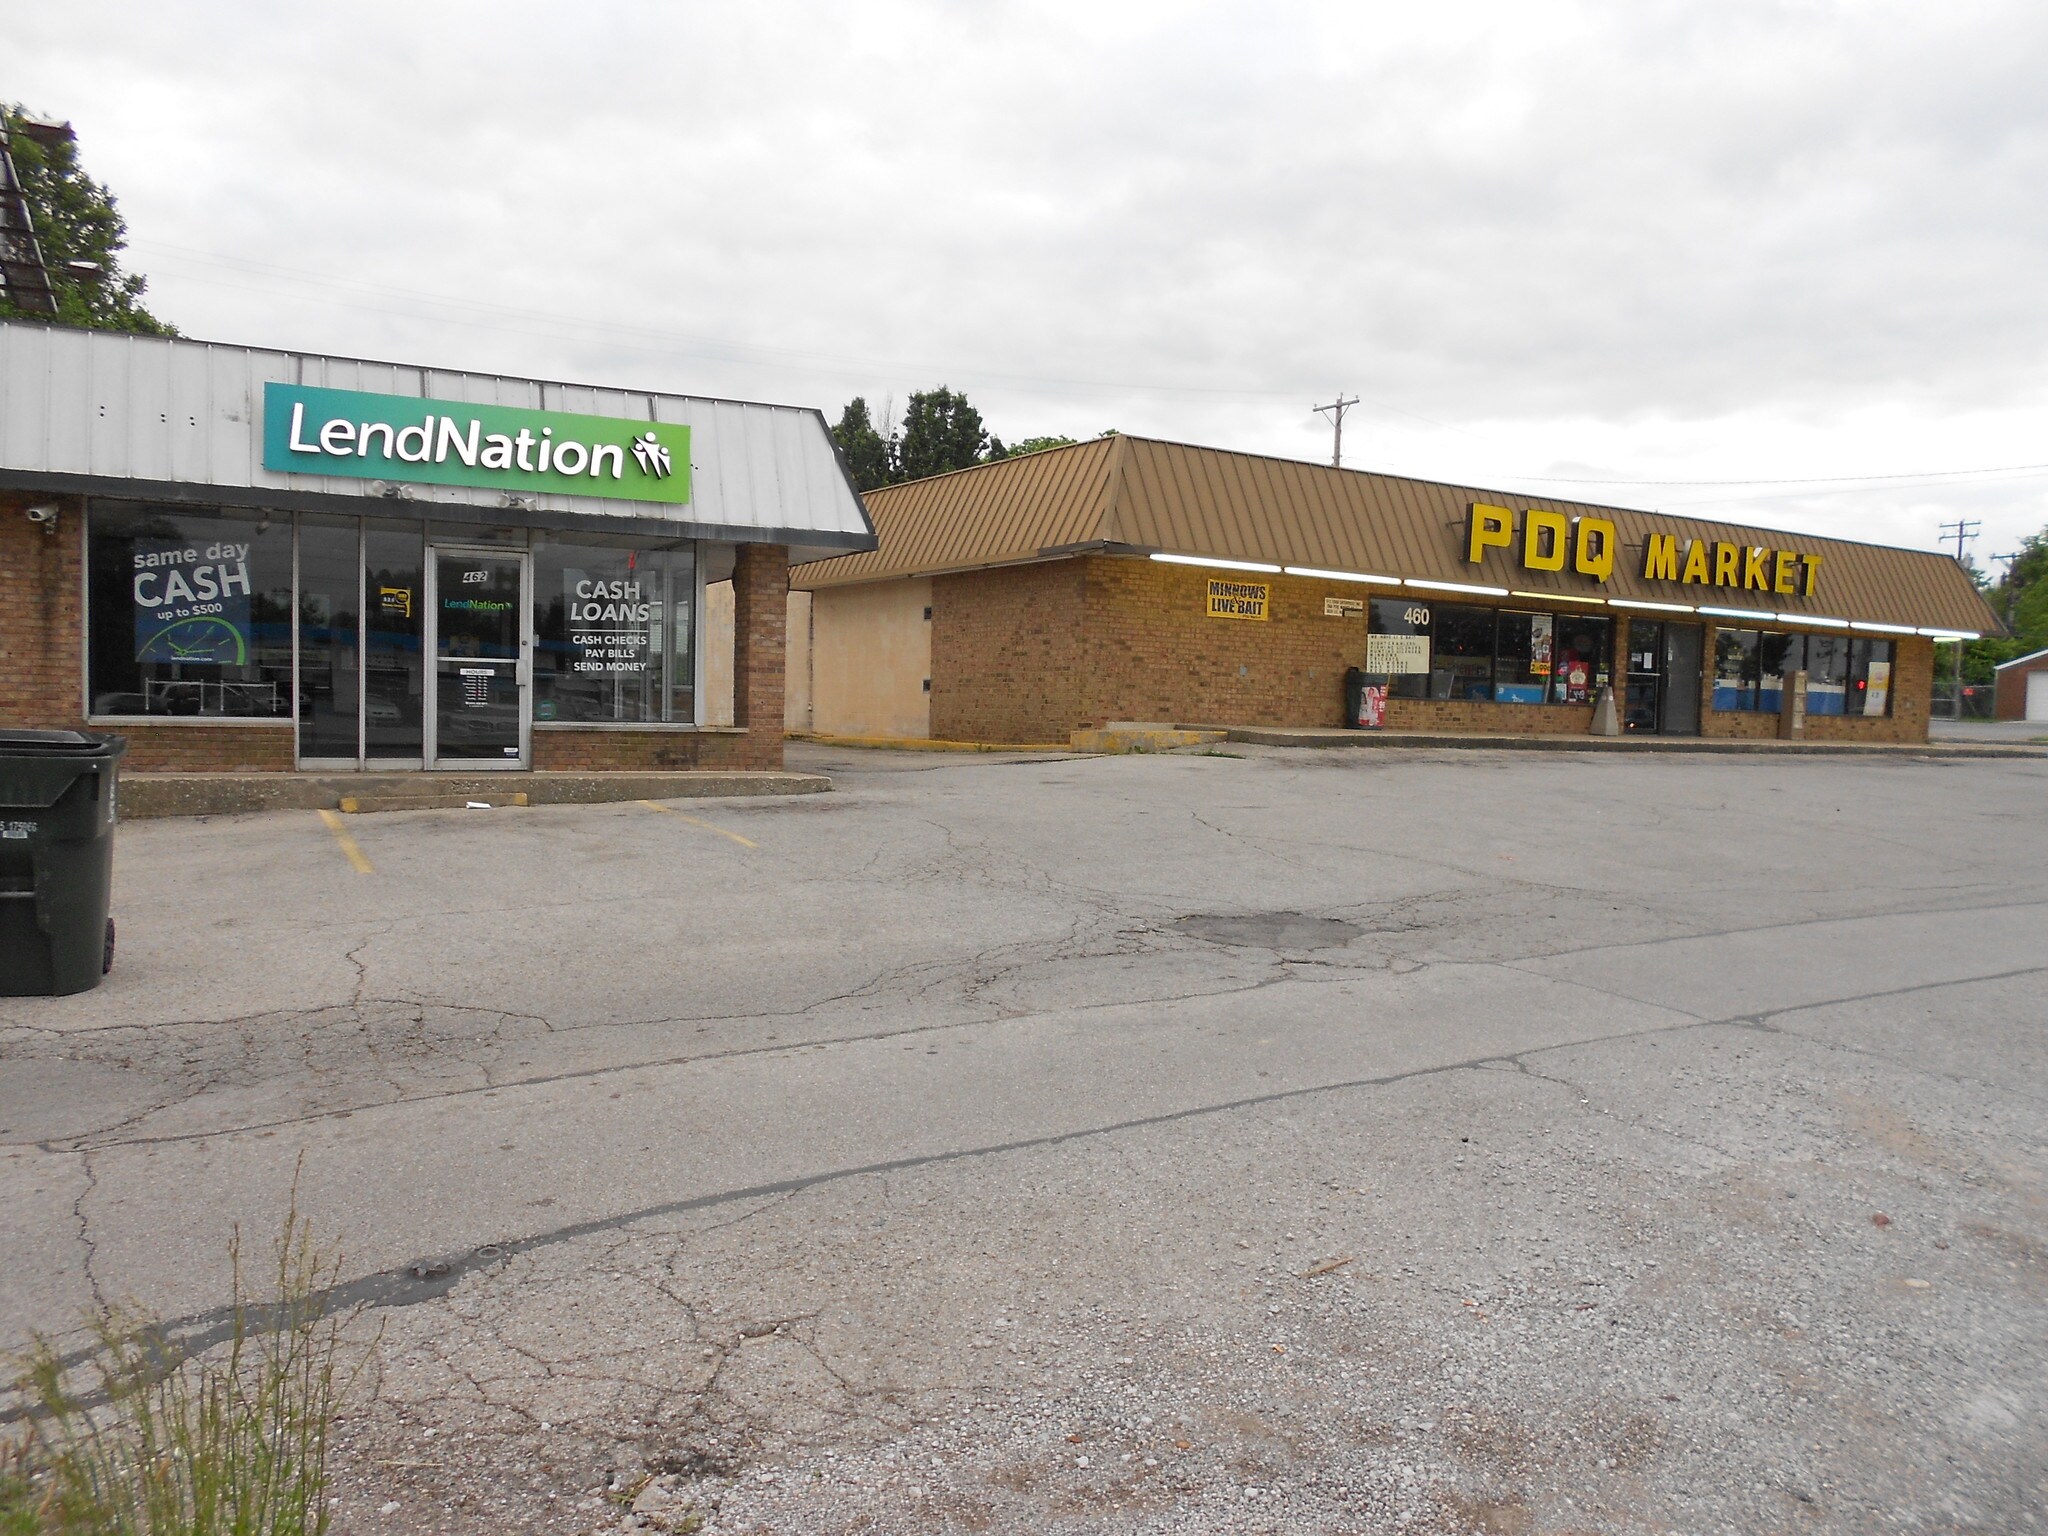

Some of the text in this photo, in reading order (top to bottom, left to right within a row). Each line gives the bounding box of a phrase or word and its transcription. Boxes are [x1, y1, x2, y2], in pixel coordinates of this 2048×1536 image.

[288, 401, 624, 479] LendNation
[134, 542, 250, 569] same day
[1466, 503, 1824, 597] PDQ MARKET
[134, 562, 251, 607] CASH
[464, 571, 486, 582] 462
[576, 580, 640, 600] CASH
[1209, 581, 1266, 600] MINNOWS
[157, 602, 223, 621] up to $500
[444, 598, 505, 610] LendNation
[570, 602, 650, 622] LOANS
[1211, 598, 1263, 615] LIVE BAIT
[1403, 607, 1430, 625] 460
[572, 635, 647, 645] CASH CHECKS
[585, 649, 635, 658] PAY BILLS
[573, 662, 647, 671] SEND MONEY
